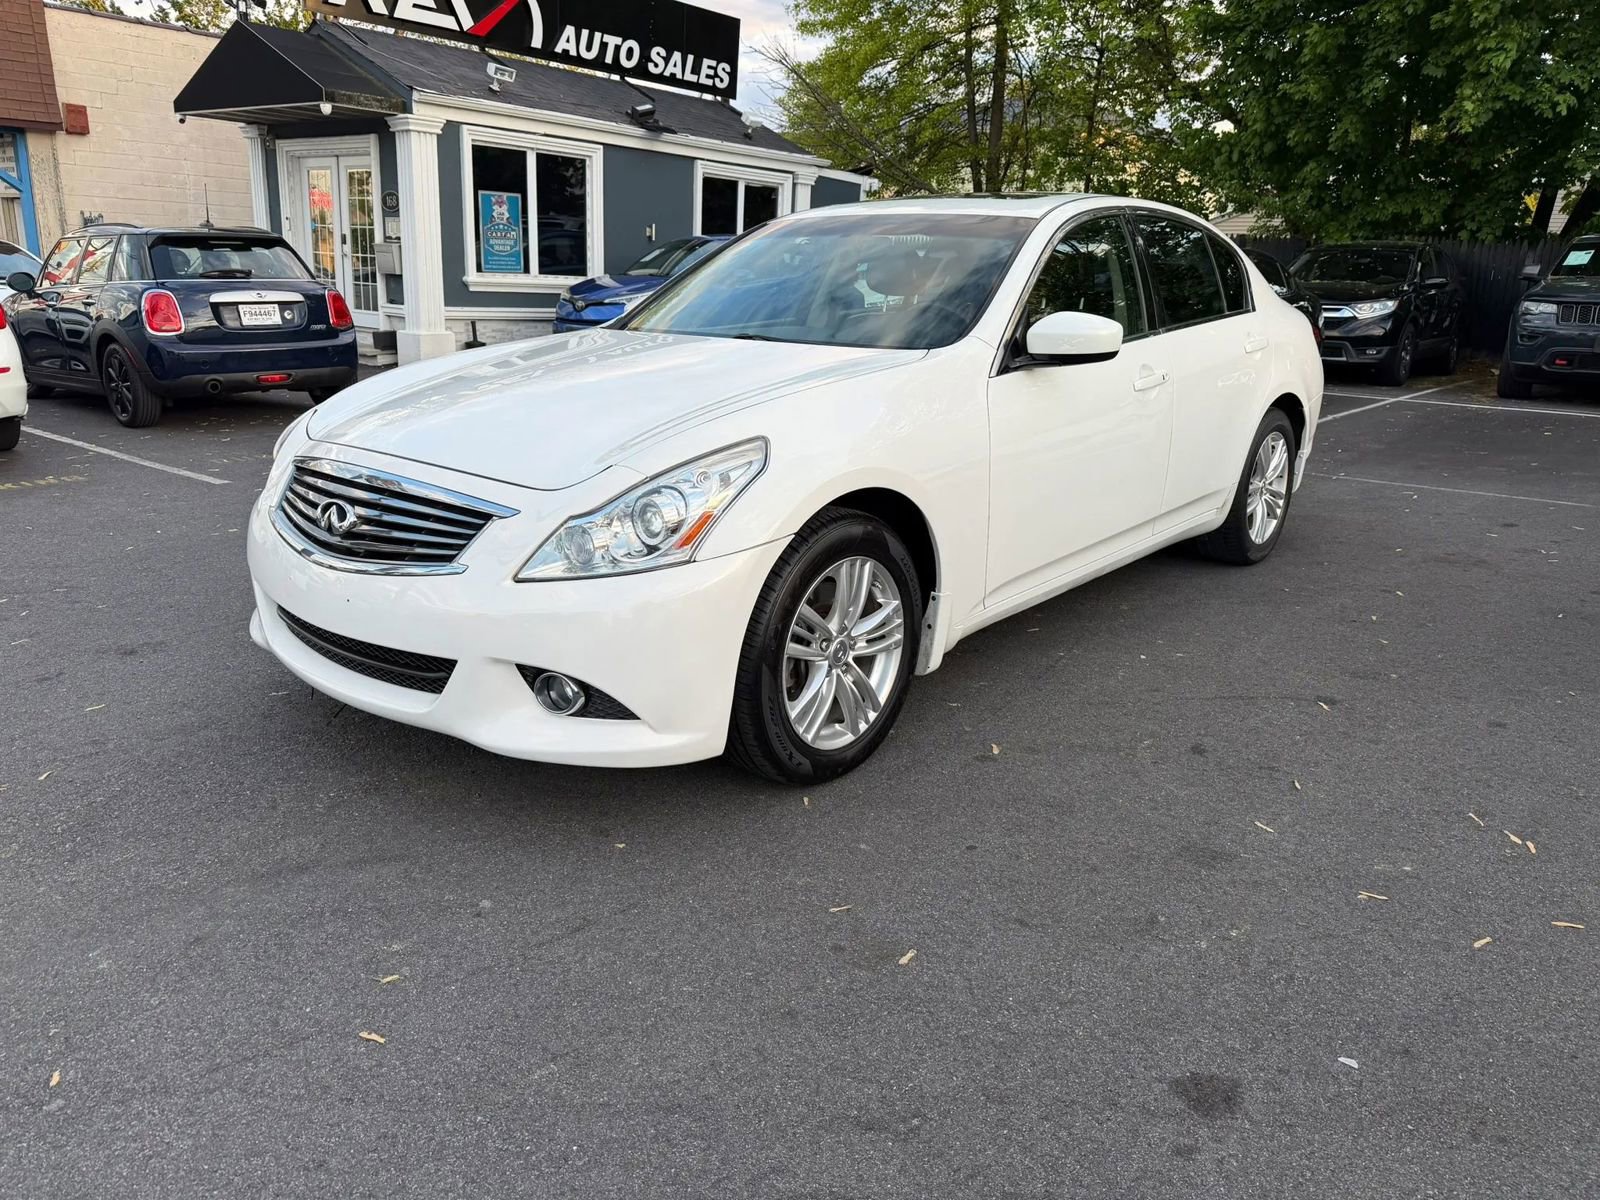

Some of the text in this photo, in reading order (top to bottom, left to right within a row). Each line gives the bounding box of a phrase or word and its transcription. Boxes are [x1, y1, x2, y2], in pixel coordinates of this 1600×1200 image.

[554, 24, 731, 89] AUTO SALES
[386, 195, 397, 207] 168
[488, 231, 517, 239] CARFAX
